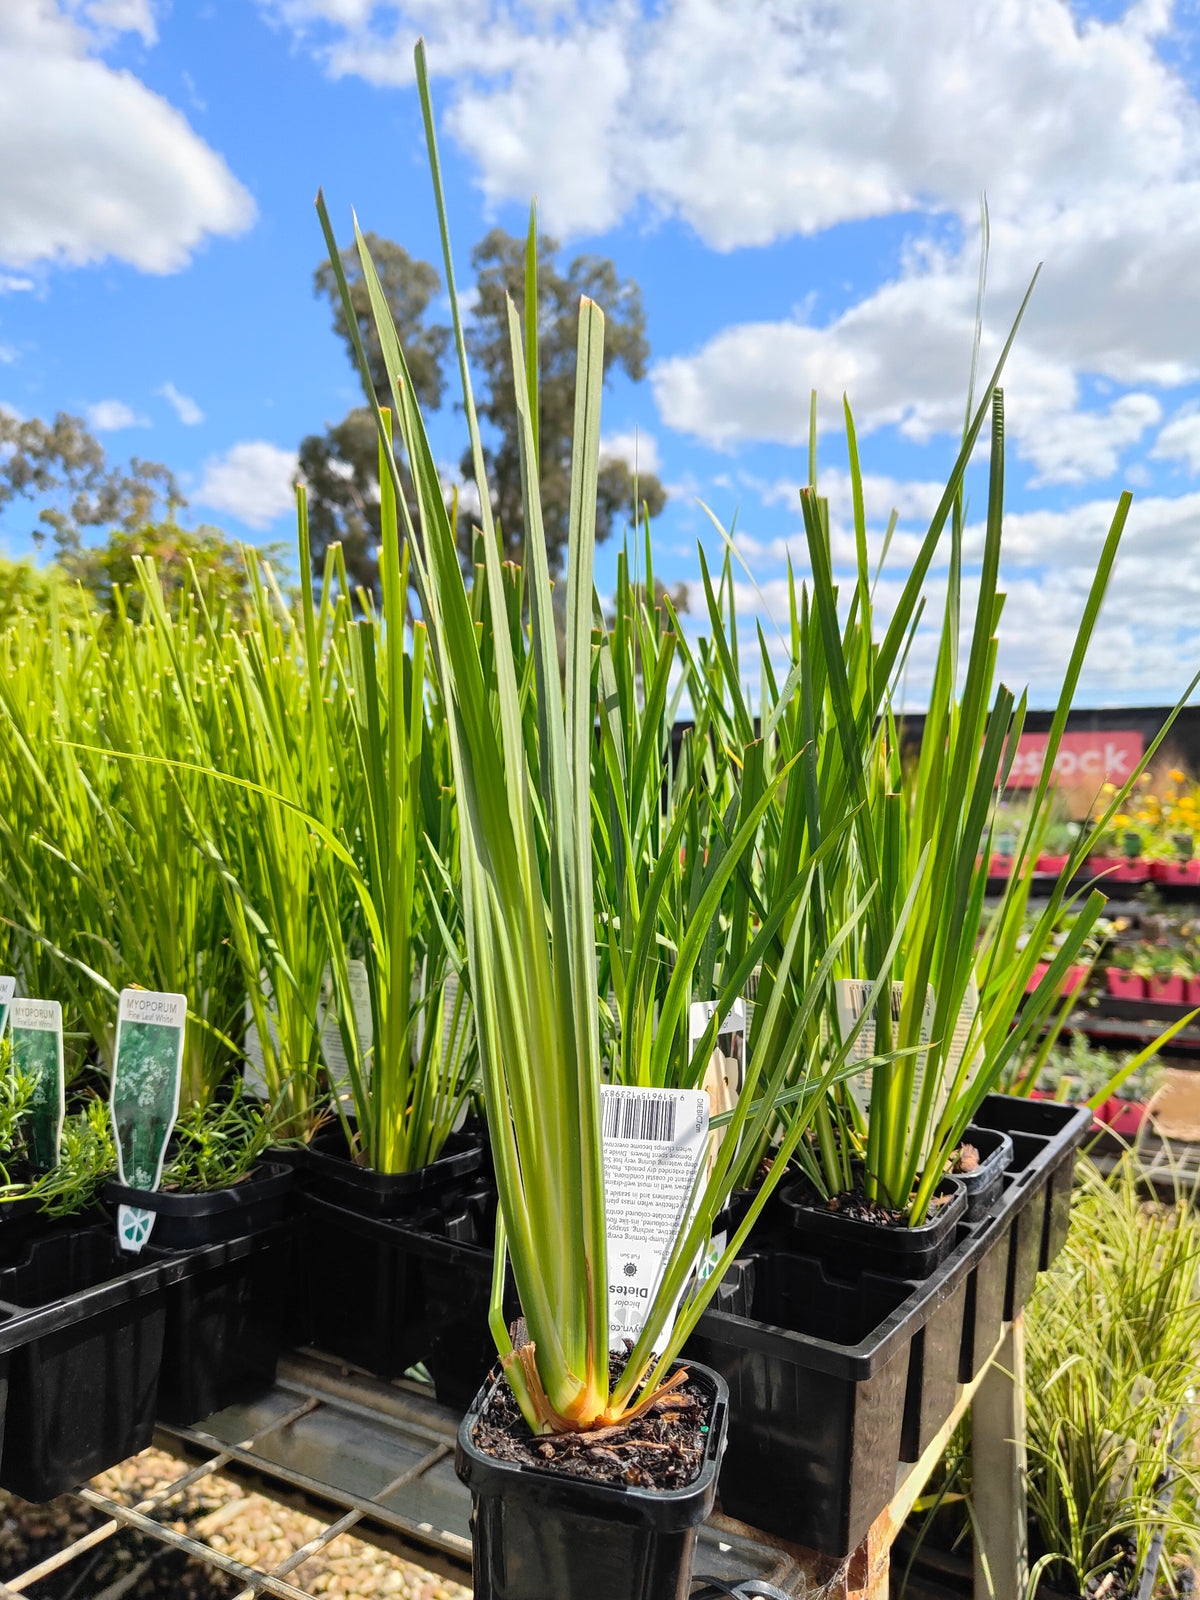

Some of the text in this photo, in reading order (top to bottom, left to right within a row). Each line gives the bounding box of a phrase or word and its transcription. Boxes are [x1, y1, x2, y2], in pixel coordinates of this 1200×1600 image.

[126, 998, 178, 1014] MYOPORUM
[15, 1007, 55, 1020] MYOPORUM
[128, 1010, 174, 1024] Fine Leaf White
[604, 1090, 636, 1099] 123983
[642, 1092, 674, 1100] 319615
[636, 1158, 656, 1166] during
[657, 1160, 682, 1168] watering
[604, 1180, 636, 1188] well-draine
[654, 1202, 679, 1210] effective
[626, 1210, 680, 1220] chocolate-coloured
[624, 1232, 668, 1244] clump-forming
[608, 1284, 648, 1298] Dietes
[614, 1300, 640, 1309] bicolor
